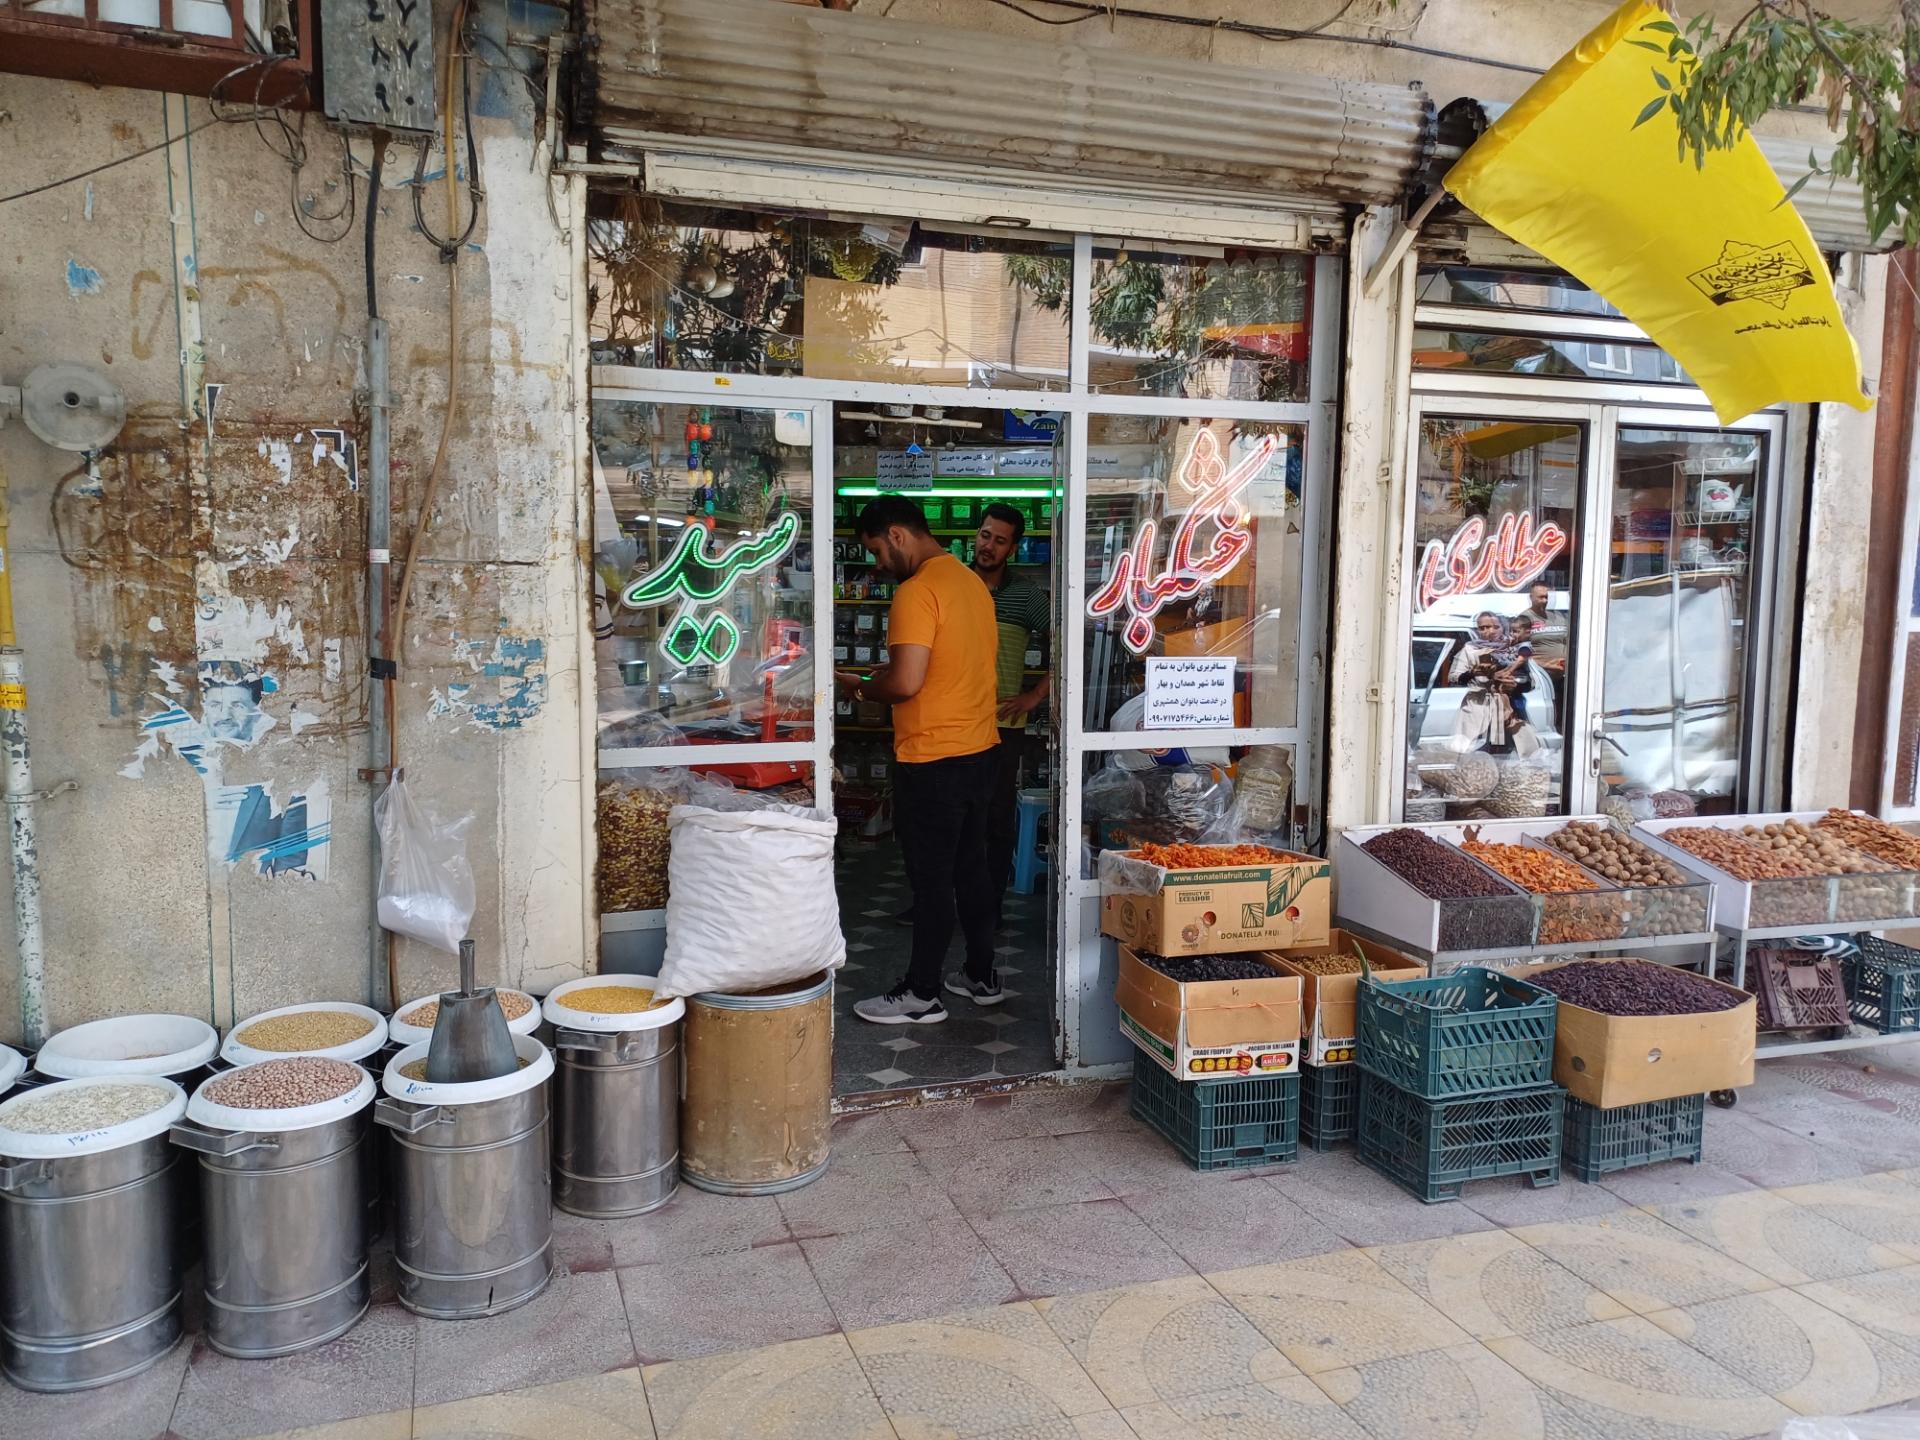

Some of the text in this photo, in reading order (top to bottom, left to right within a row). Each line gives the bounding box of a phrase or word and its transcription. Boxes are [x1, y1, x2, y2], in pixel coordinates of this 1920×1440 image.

[1087, 428, 1276, 655] خشکبار
[1416, 511, 1567, 614] عطاری
[1155, 662, 1168, 672] تمام
[1176, 662, 1195, 672] بانوان
[1196, 662, 1227, 672] مسافربری
[1174, 679, 1195, 689] همدان
[1198, 679, 1209, 689] شهر
[1211, 679, 1224, 687] نقاط
[1152, 697, 1179, 707] همشهری
[1180, 698, 1198, 707] بانوان
[1220, 698, 1227, 706] در
[1172, 871, 1261, 882] www.donatellafruit.com
[1221, 931, 1263, 940] DONATELLA
